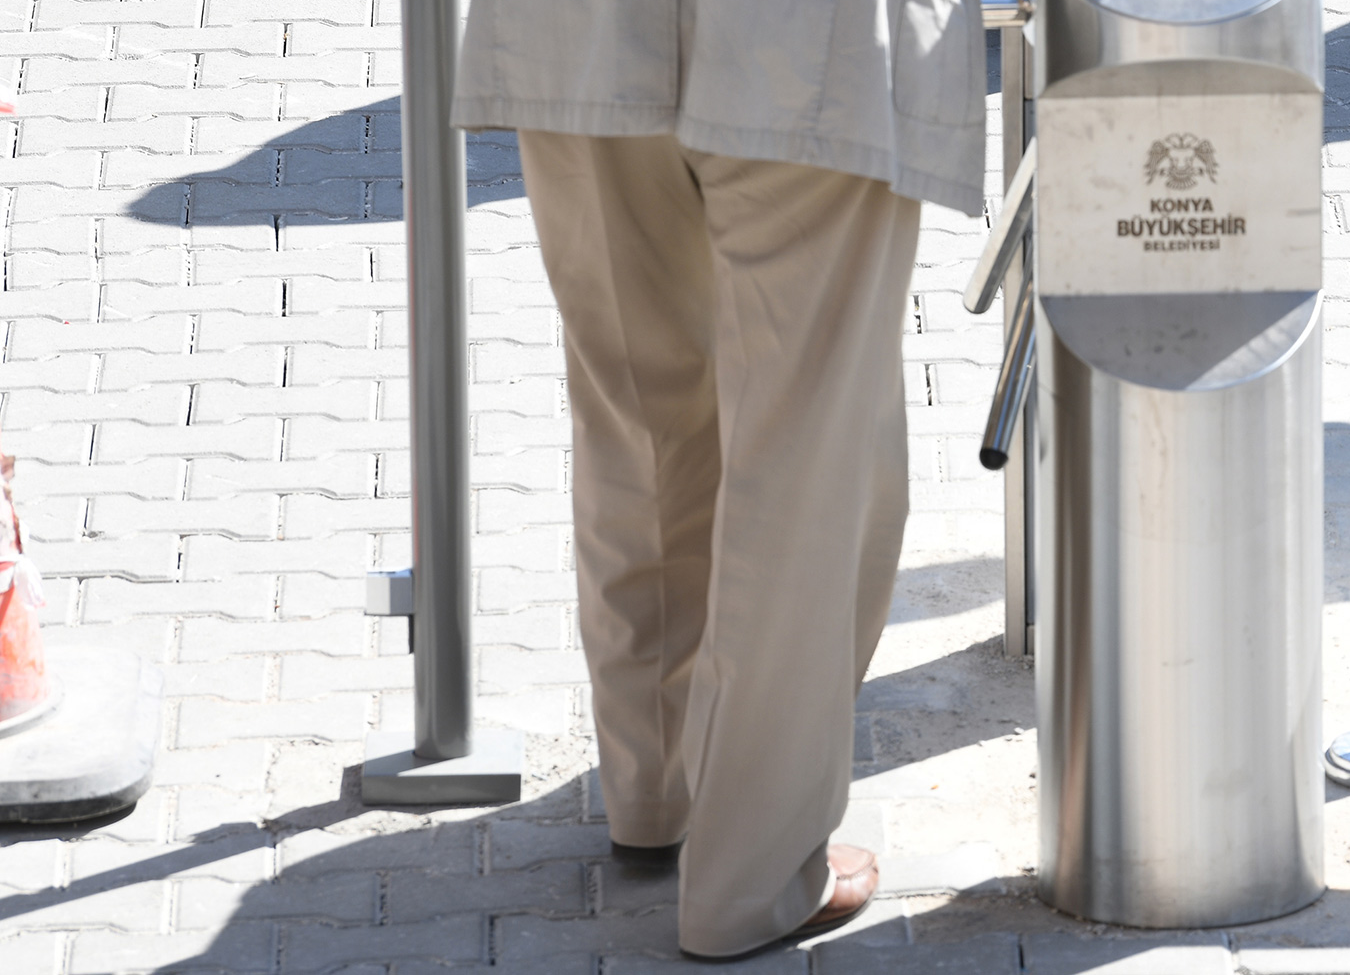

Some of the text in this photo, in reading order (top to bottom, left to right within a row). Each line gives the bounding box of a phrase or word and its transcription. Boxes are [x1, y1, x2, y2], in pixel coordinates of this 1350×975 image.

[1150, 198, 1213, 213] KONYA
[1117, 214, 1246, 236] BÜYÜKŞEHİR
[1143, 239, 1220, 251] BELEDİYESİ
